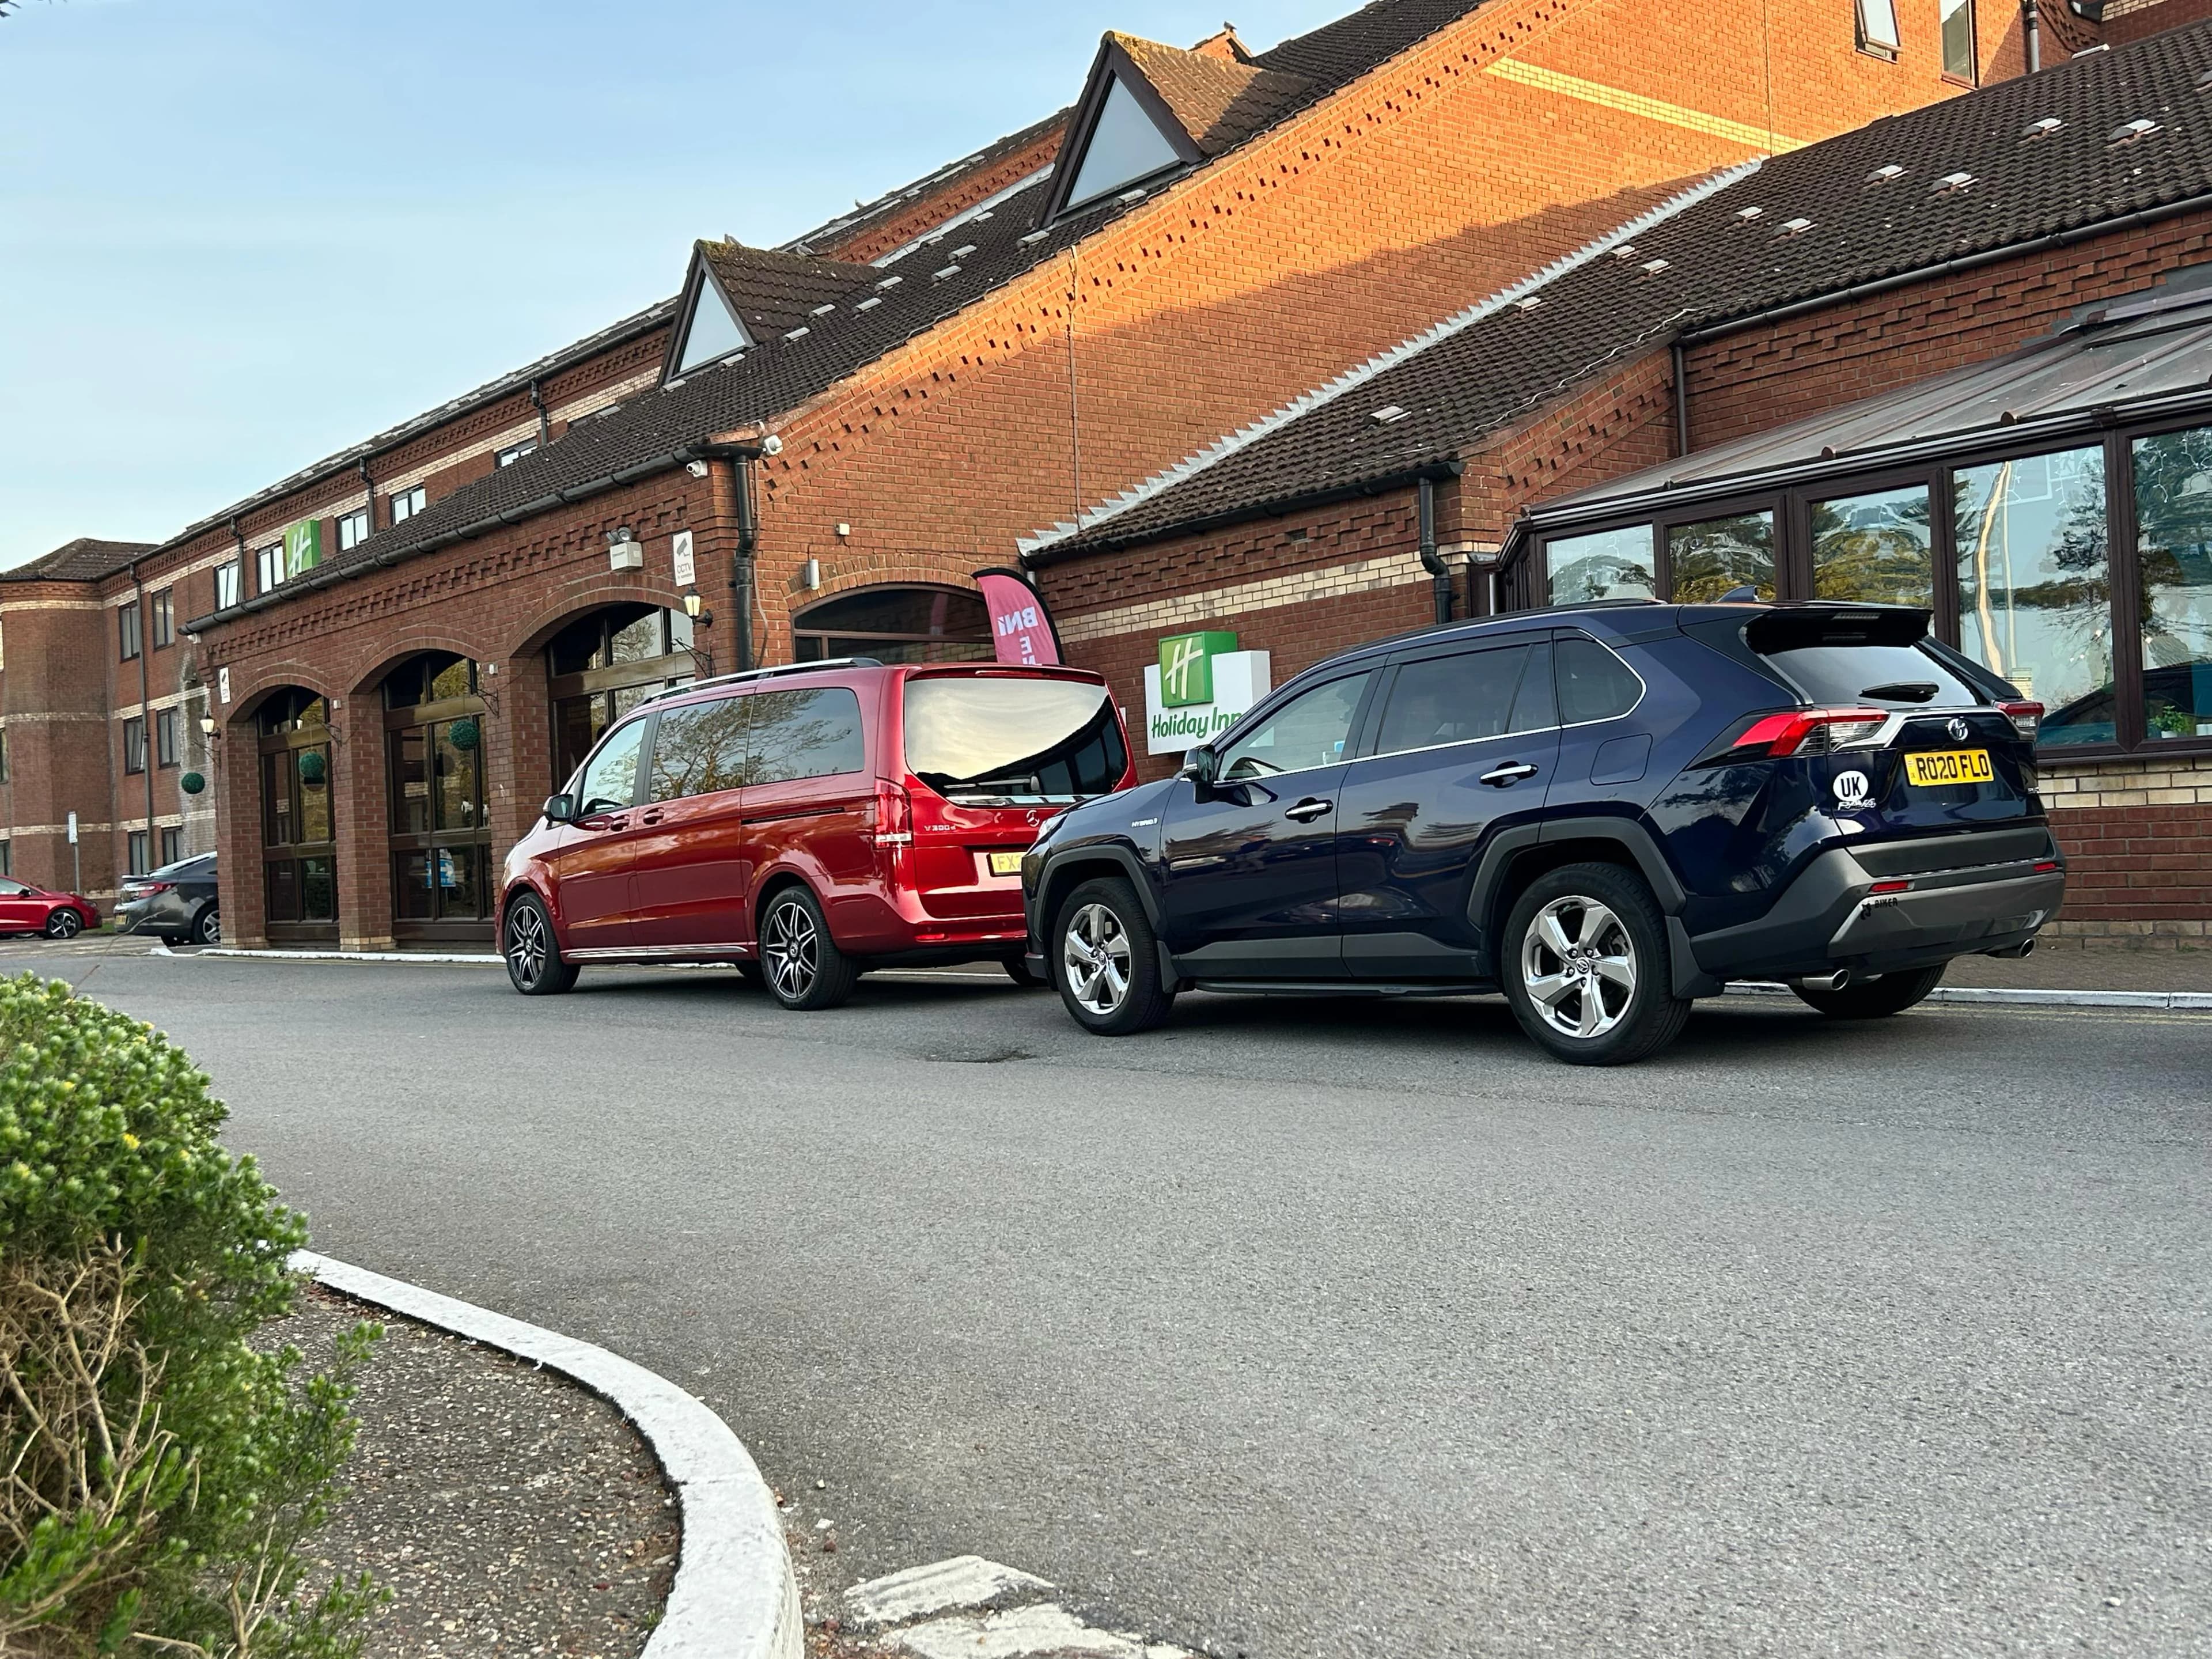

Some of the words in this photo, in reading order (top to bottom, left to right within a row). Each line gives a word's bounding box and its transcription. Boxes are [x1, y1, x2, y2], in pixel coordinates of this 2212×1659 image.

[677, 563, 691, 574] CCTV
[1152, 711, 1209, 738] Holiday
[1959, 754, 1990, 778] FLO
[1840, 776, 1861, 797] UK
